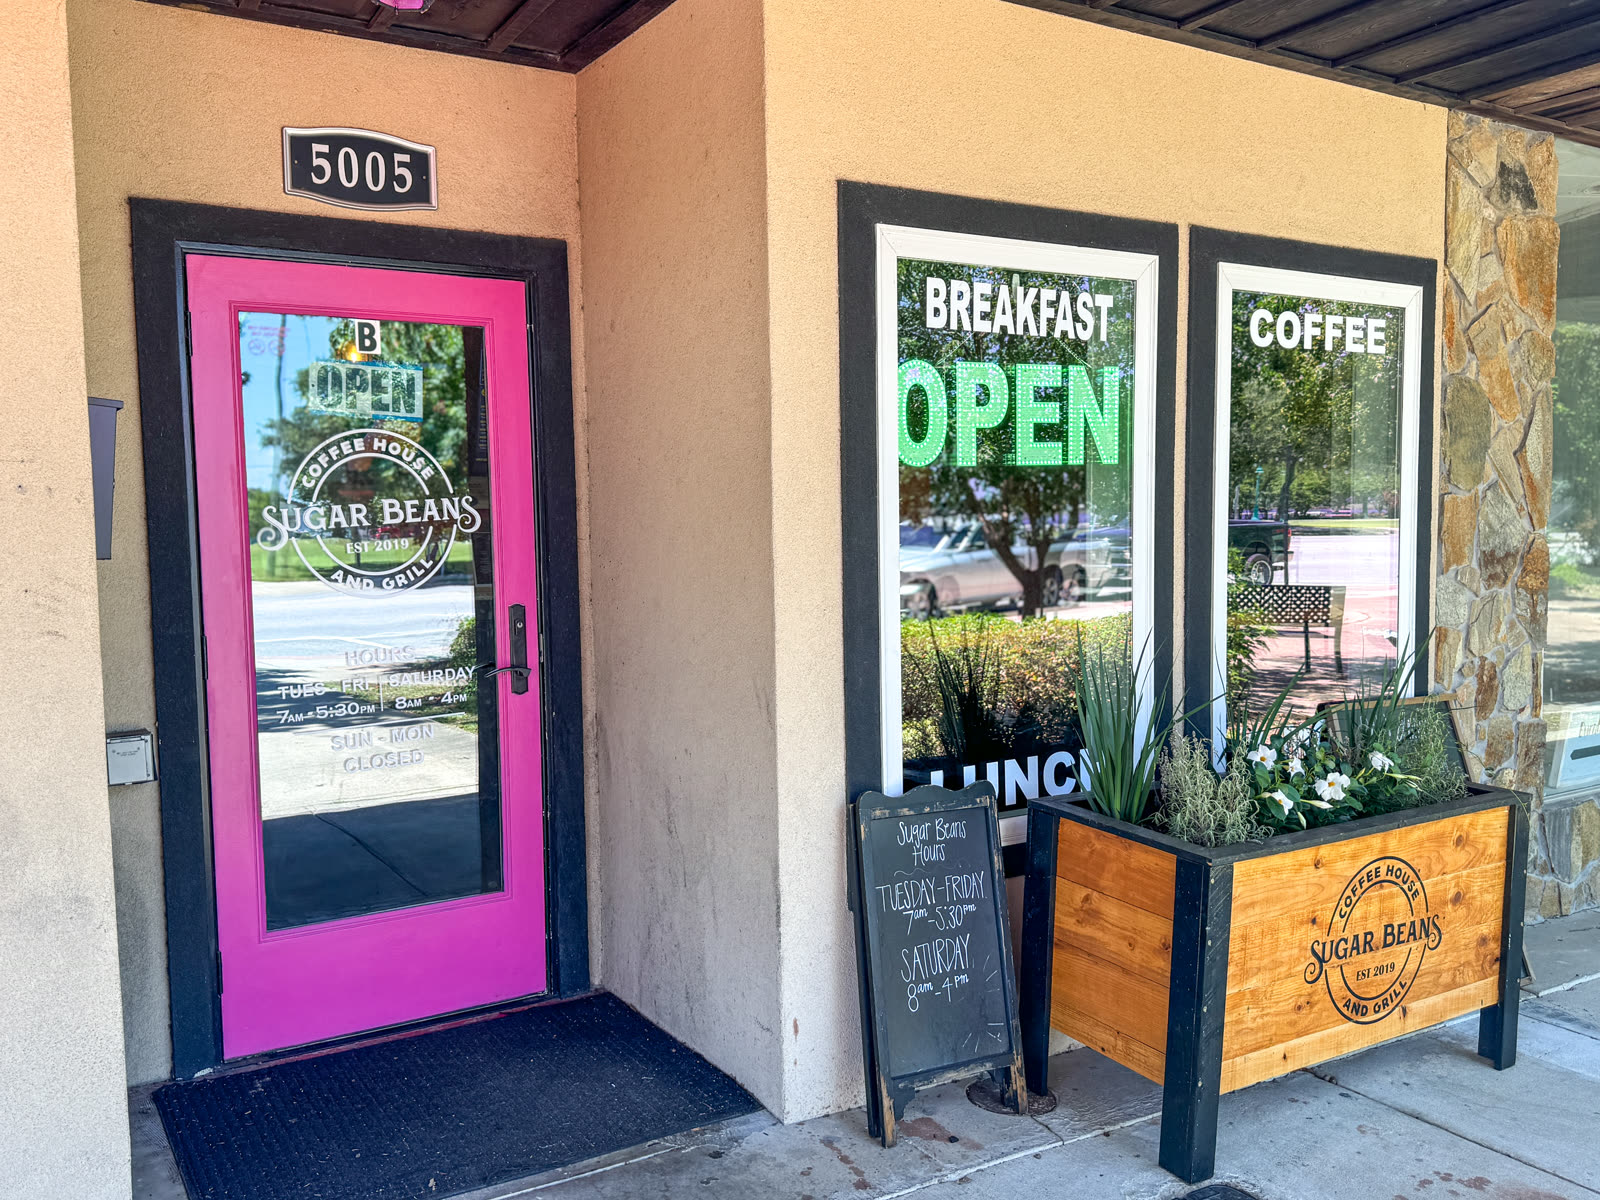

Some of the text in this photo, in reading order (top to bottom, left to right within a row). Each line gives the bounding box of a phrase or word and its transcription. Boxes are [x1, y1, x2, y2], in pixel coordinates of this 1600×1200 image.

[311, 143, 413, 193] 5005
[926, 276, 1113, 341] BREAKFAST
[357, 321, 377, 351] B
[1250, 308, 1387, 354] COFFEE
[317, 364, 416, 413] OPEN
[897, 359, 1119, 467] OPEN
[302, 437, 435, 488] COFFEE HOUSE
[256, 495, 482, 551] SUGAR BEANS
[346, 538, 409, 554] EST 2019
[331, 557, 434, 591] AND GRILL
[345, 645, 416, 667] HOURS
[277, 682, 326, 700] TUES
[341, 675, 369, 693] FRI
[389, 665, 476, 687] SATURDAY
[331, 731, 373, 751] SUN
[390, 724, 434, 743] MON
[343, 748, 425, 773] CLOSED
[897, 817, 967, 848] Sugar Beans
[912, 843, 945, 866] Hours
[1338, 864, 1420, 919] COFFEE HOUSE
[900, 932, 970, 982] SATURDAY
[1303, 914, 1442, 985] SUGAR BEANS
[1356, 962, 1396, 982] EST 2019
[1342, 979, 1407, 1017] AND GRILL
